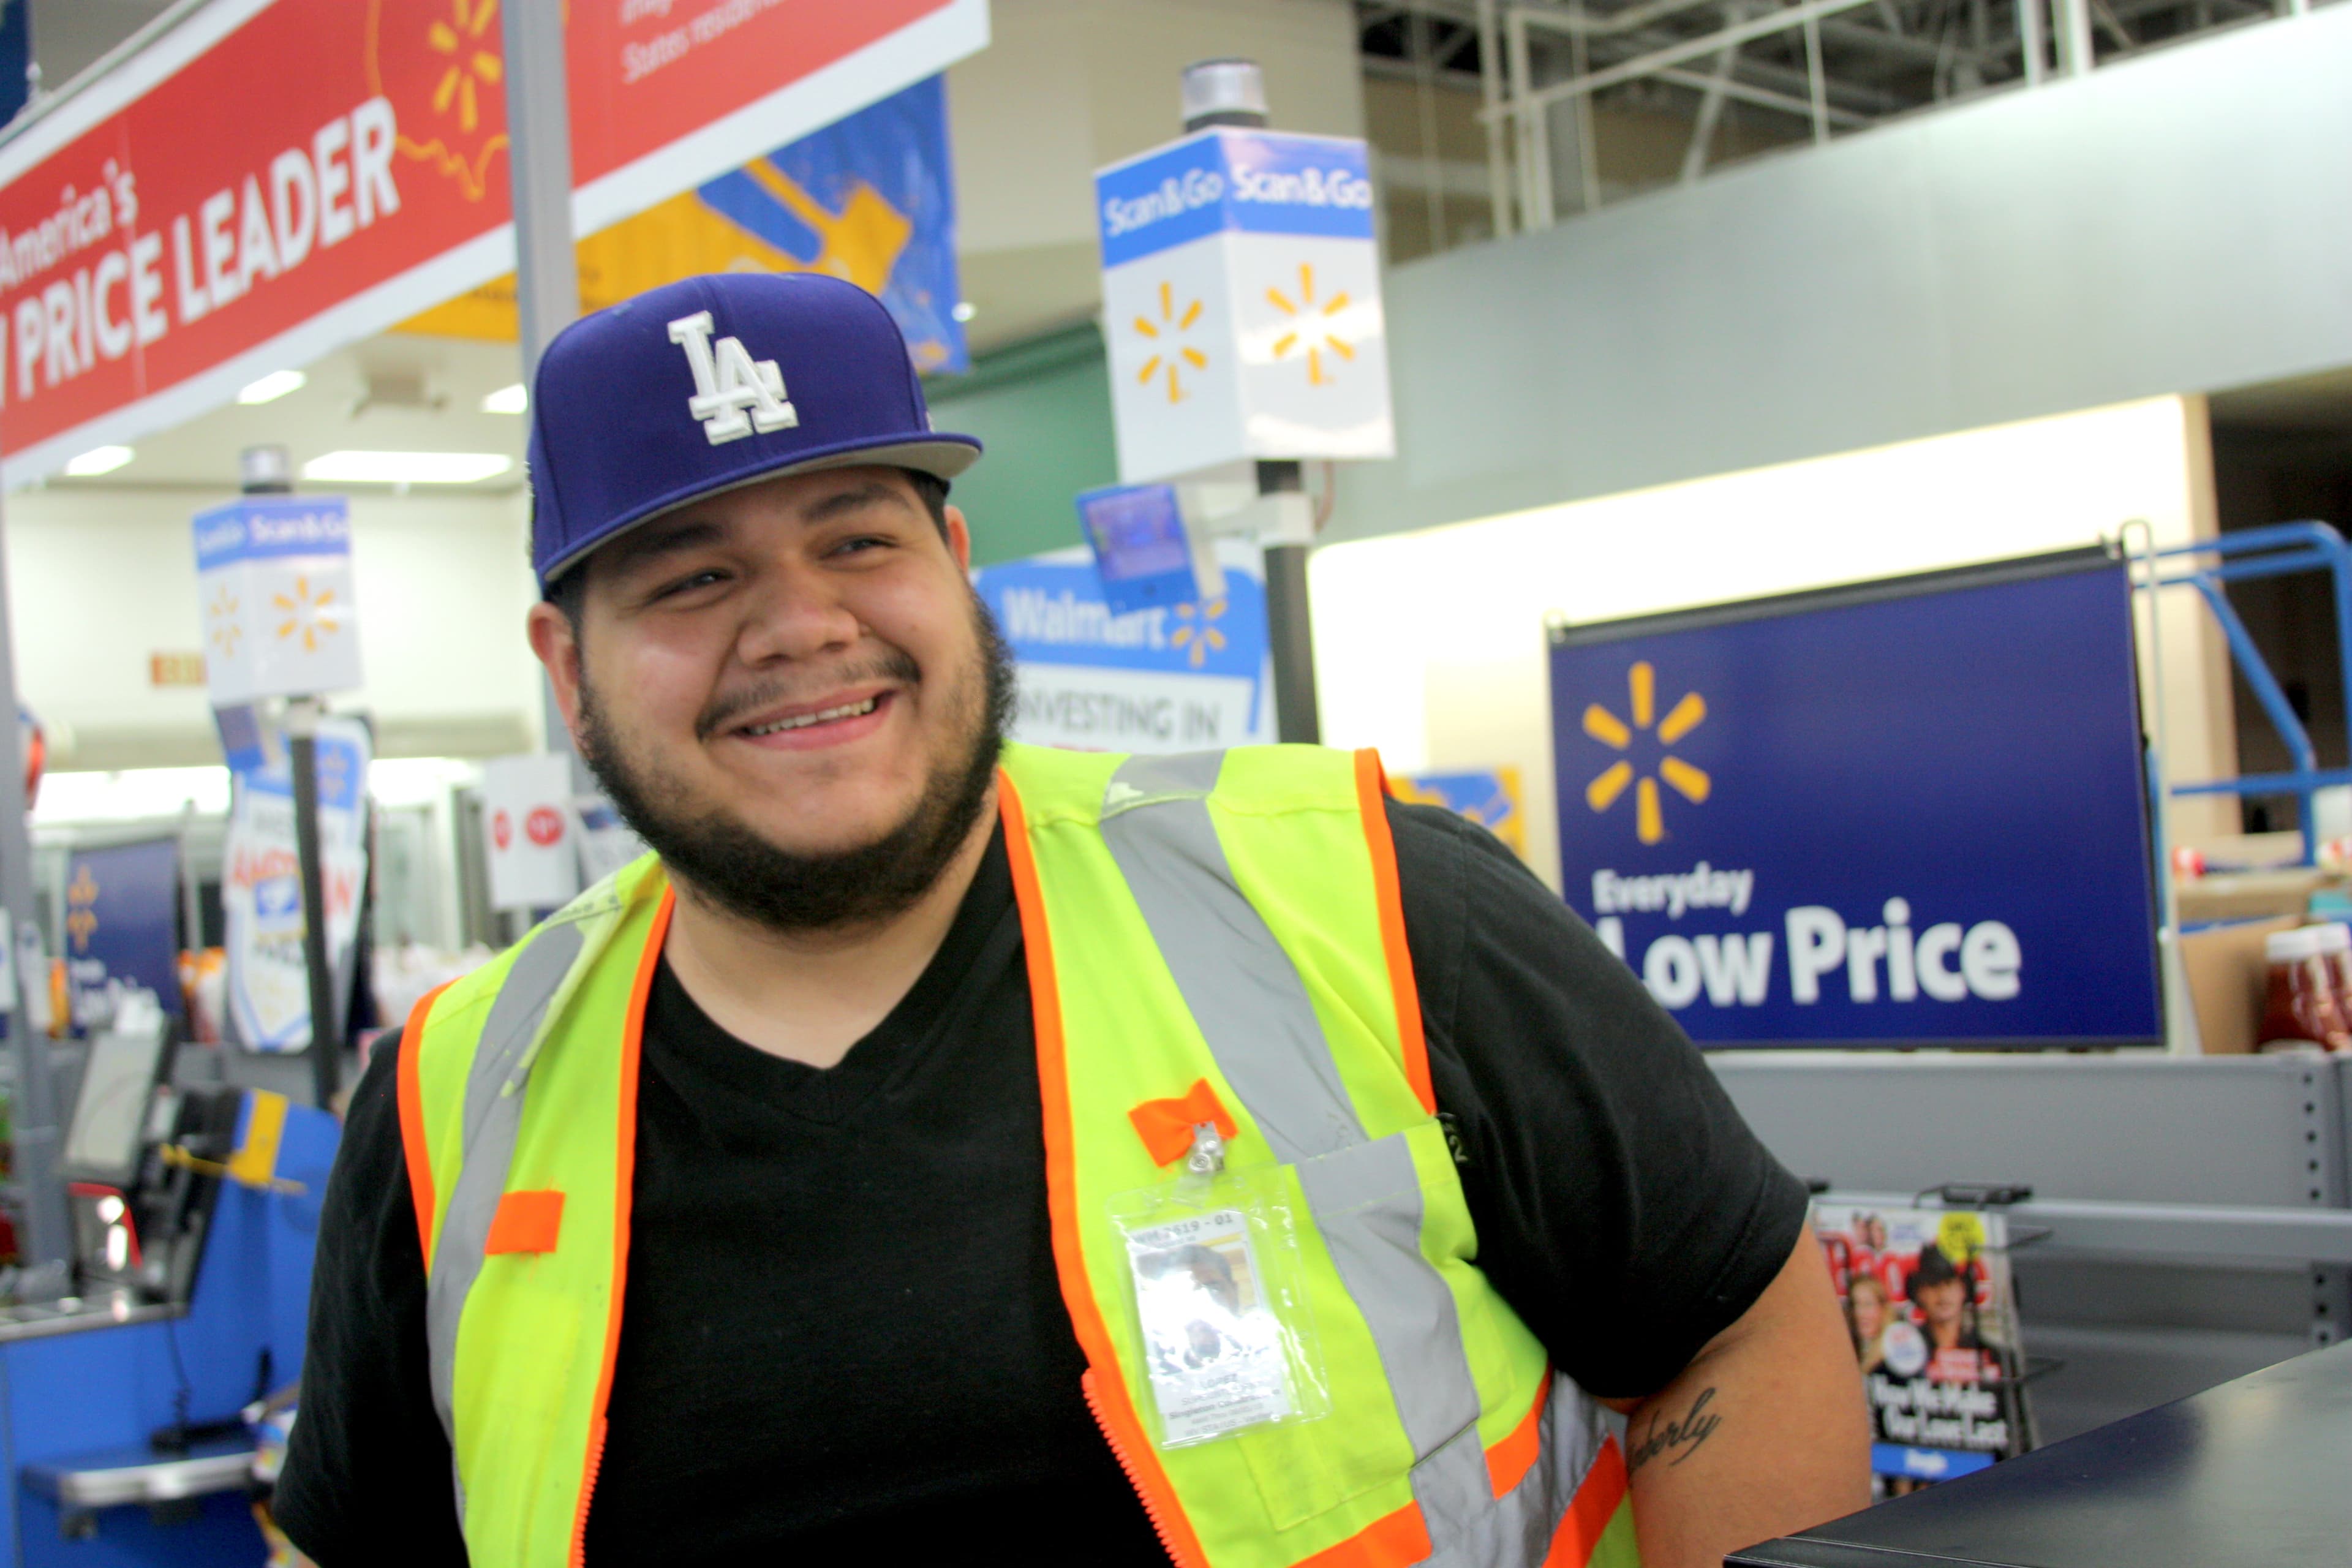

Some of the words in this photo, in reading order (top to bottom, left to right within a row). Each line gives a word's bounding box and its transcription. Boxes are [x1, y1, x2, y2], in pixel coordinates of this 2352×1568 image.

[1104, 168, 1223, 237] Scan&Go
[1231, 164, 1373, 210] Scan&Go
[15, 230, 169, 402] PRICE
[173, 94, 401, 325] LEADER
[667, 309, 799, 447] LA
[1001, 587, 1168, 652] Walmart
[1020, 687, 1175, 742] NVESTING
[1181, 698, 1221, 742] IN
[1591, 859, 1754, 919] Everyday
[1785, 895, 2022, 1006] Price
